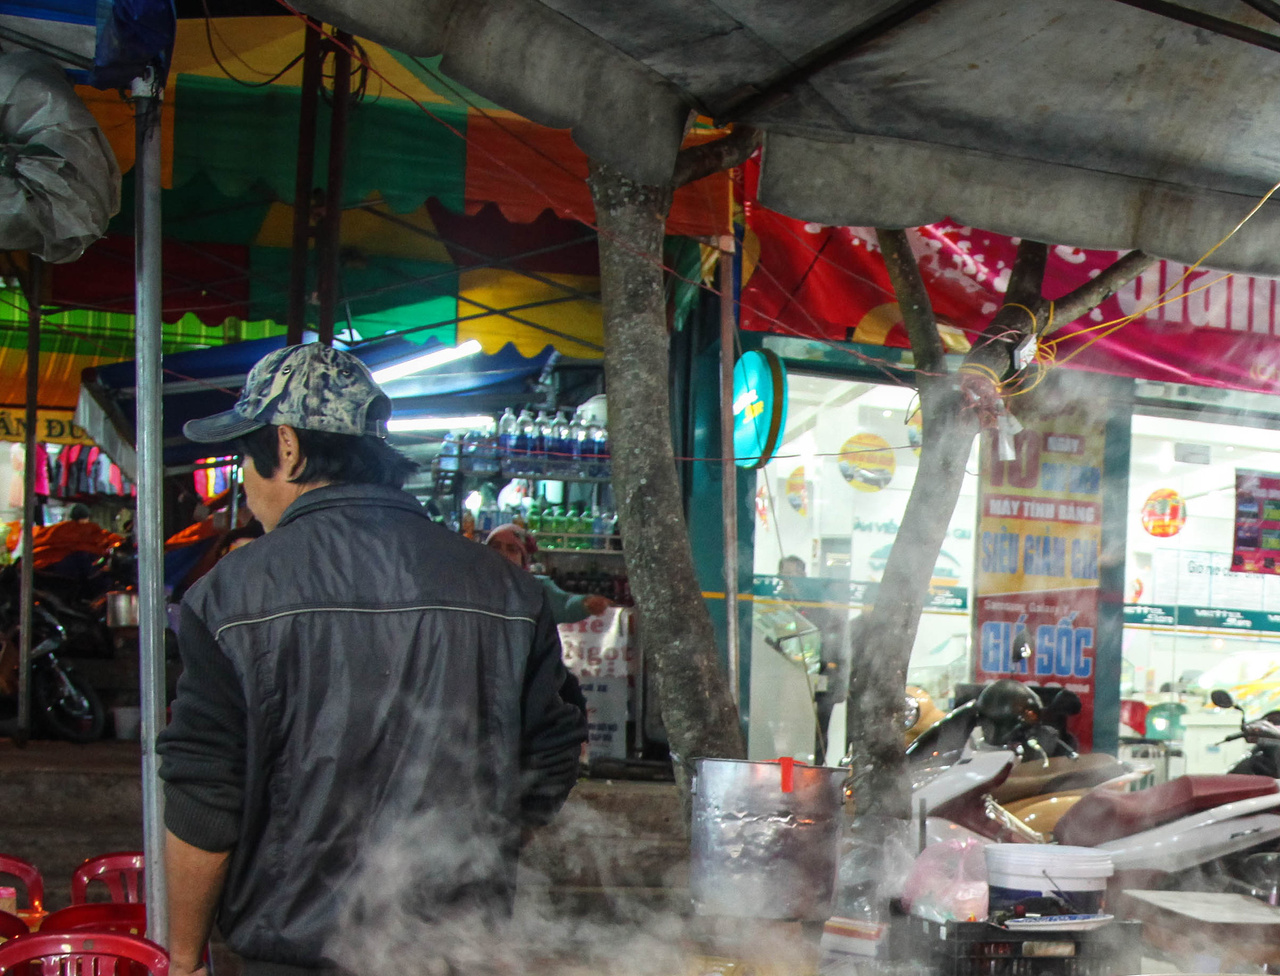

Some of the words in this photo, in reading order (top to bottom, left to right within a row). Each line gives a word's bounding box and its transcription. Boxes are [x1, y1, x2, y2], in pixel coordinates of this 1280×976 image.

[989, 497, 1019, 515] MÁY
[1023, 499, 1055, 518] TÍNH
[981, 525, 1019, 574] SIÊU
[1023, 526, 1066, 577] GIẢM
[981, 613, 1029, 674] GIÁ
[1034, 610, 1094, 678] SỐC
